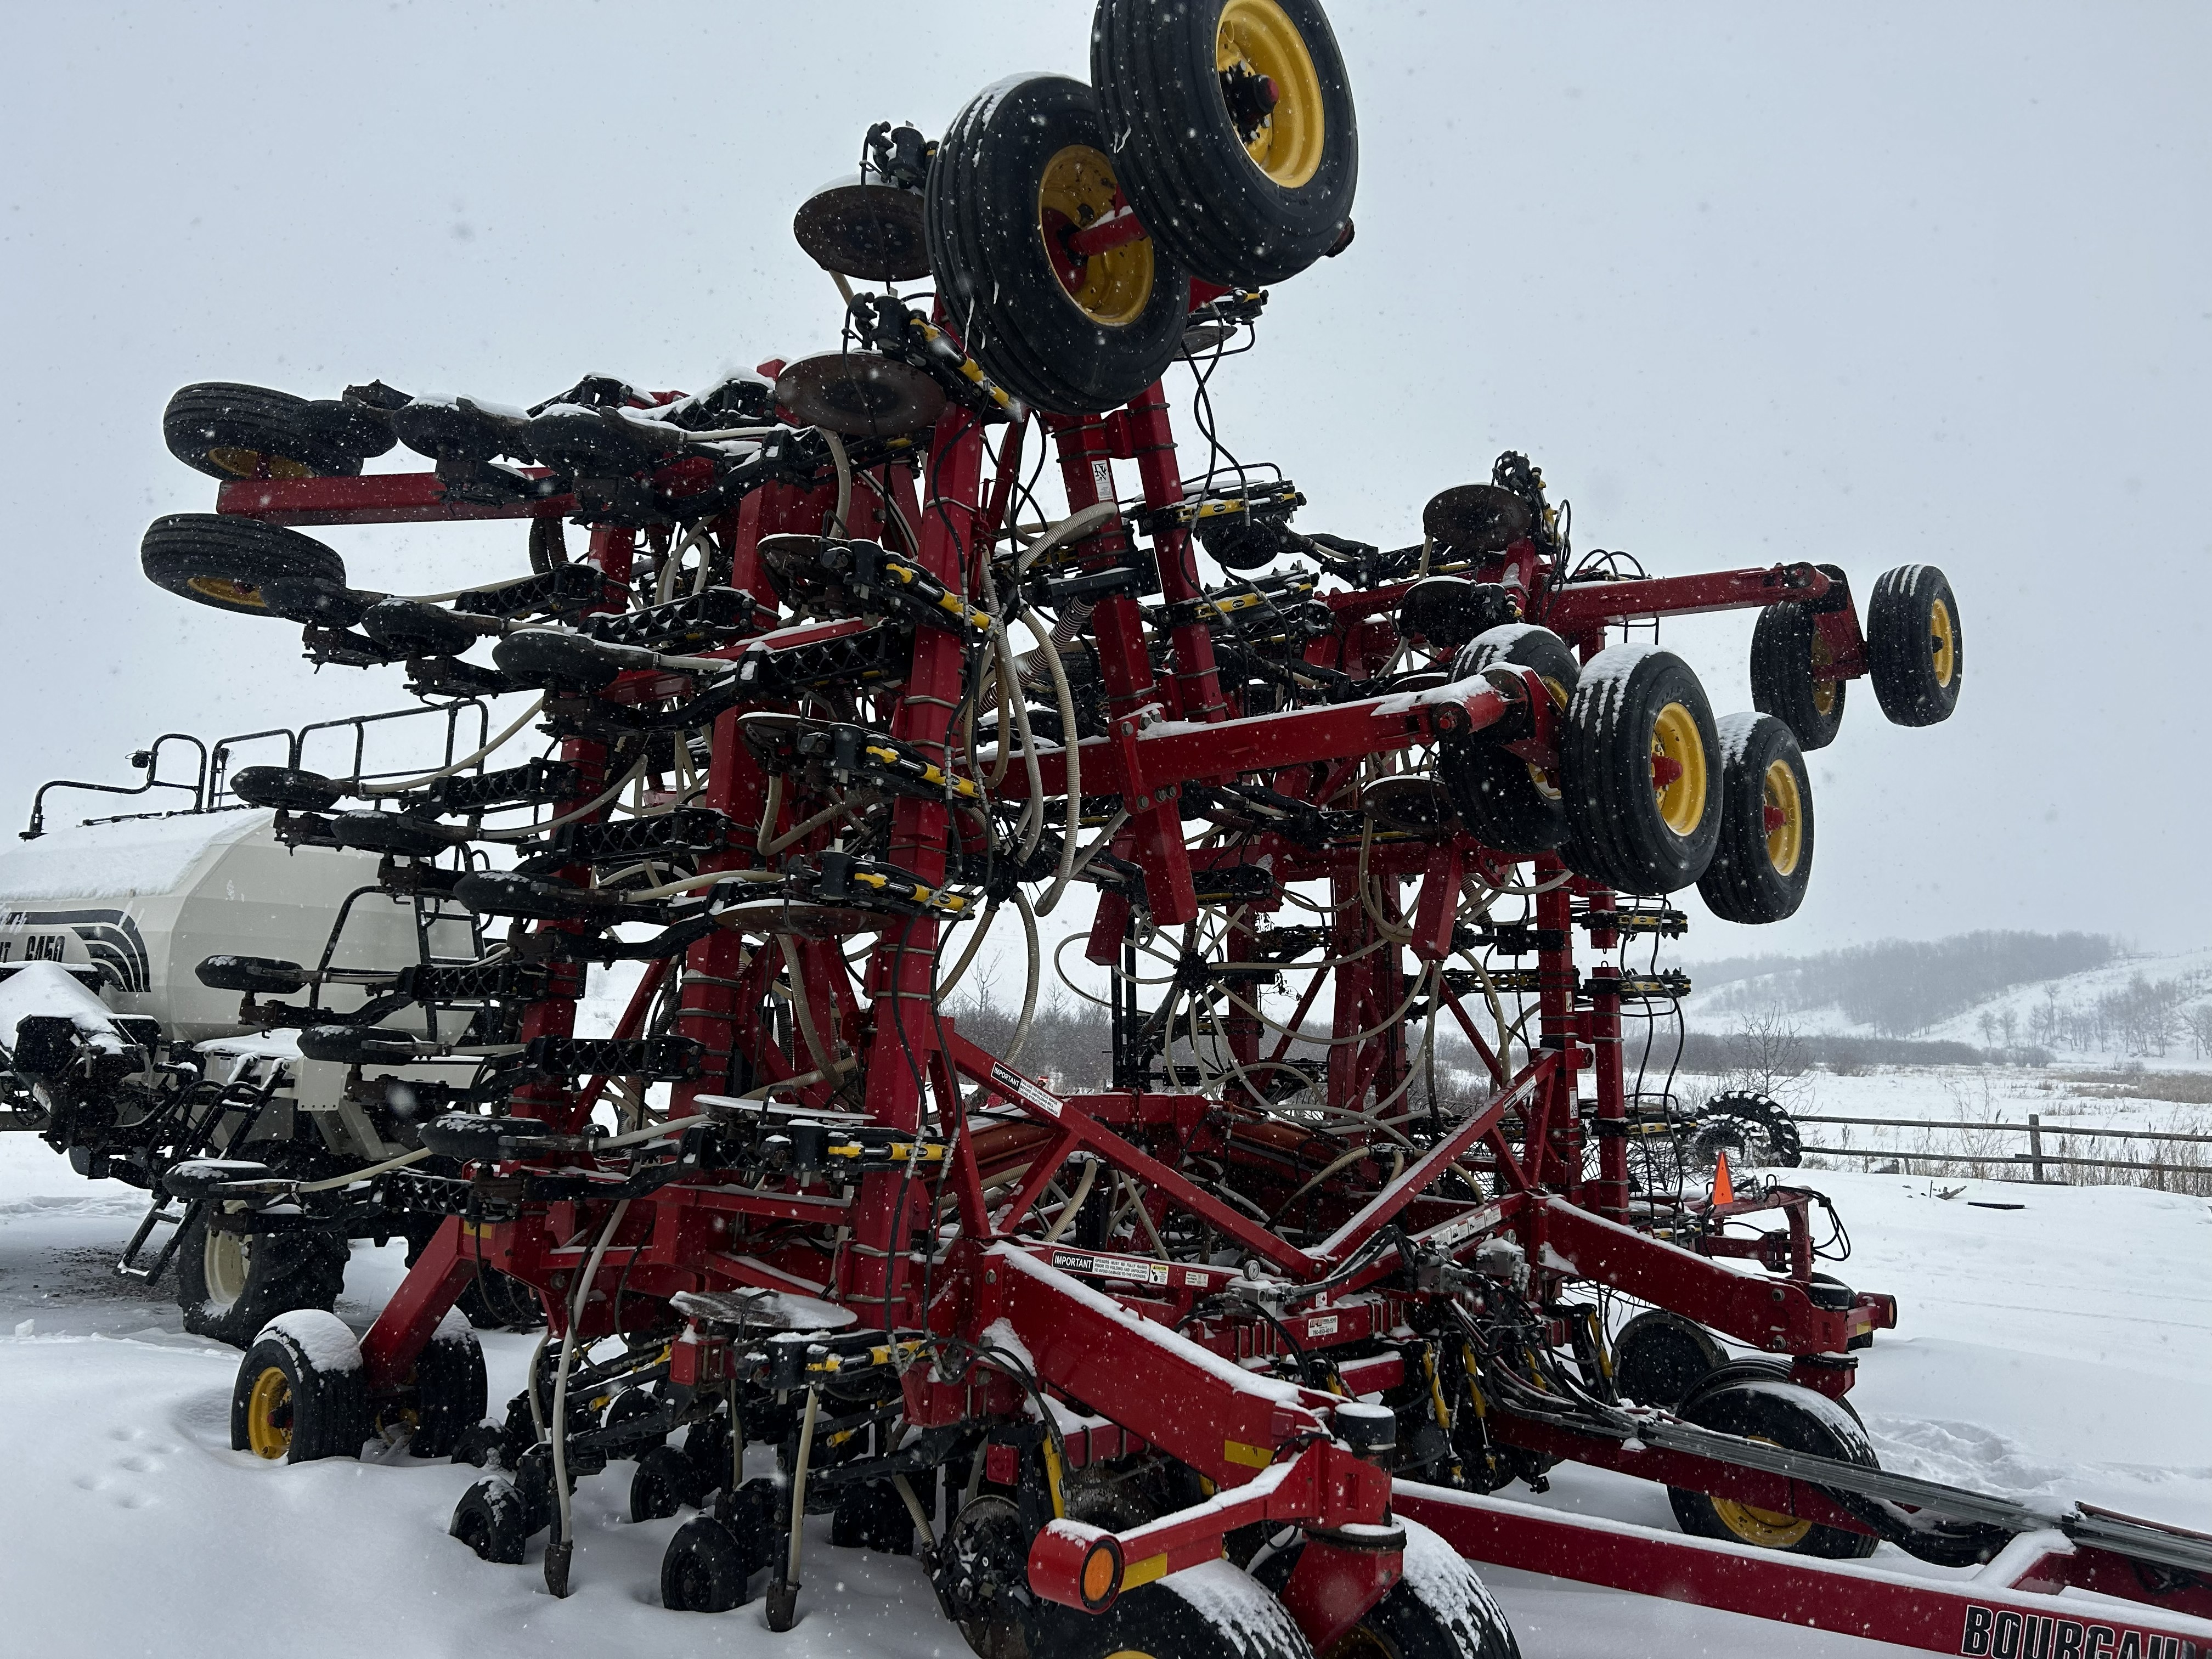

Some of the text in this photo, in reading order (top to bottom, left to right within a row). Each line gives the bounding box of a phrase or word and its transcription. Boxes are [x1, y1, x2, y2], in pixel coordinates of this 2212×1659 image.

[994, 1066, 1020, 1087] IMPORTANT
[1054, 1255, 1092, 1269] IMPORTANT
[1961, 1604, 2212, 1659] BOURGA
